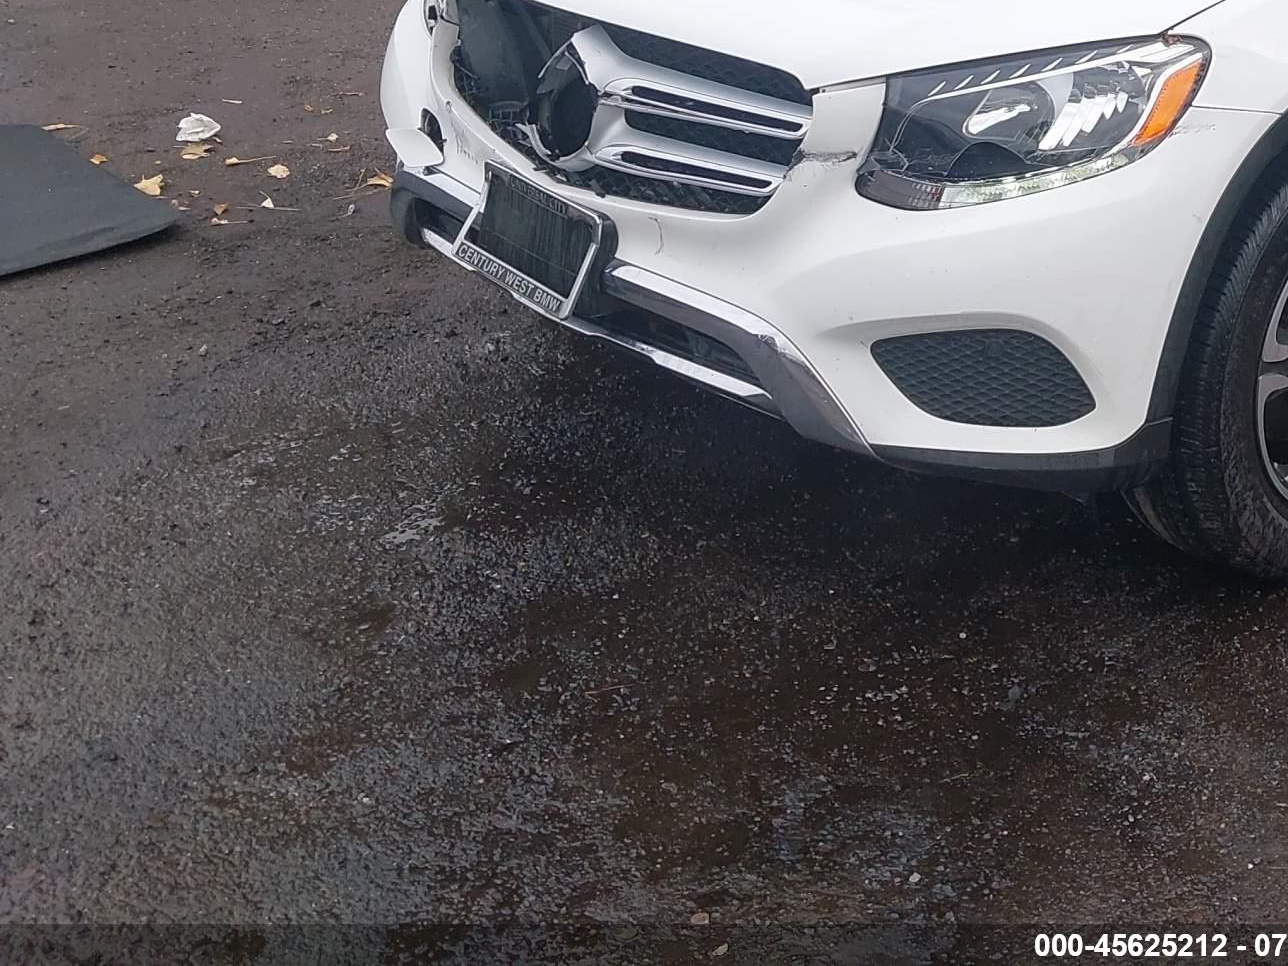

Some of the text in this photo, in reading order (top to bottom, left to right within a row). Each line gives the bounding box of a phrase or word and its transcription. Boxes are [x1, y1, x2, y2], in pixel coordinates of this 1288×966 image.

[458, 244, 561, 312] CENTURY WEST BMW
